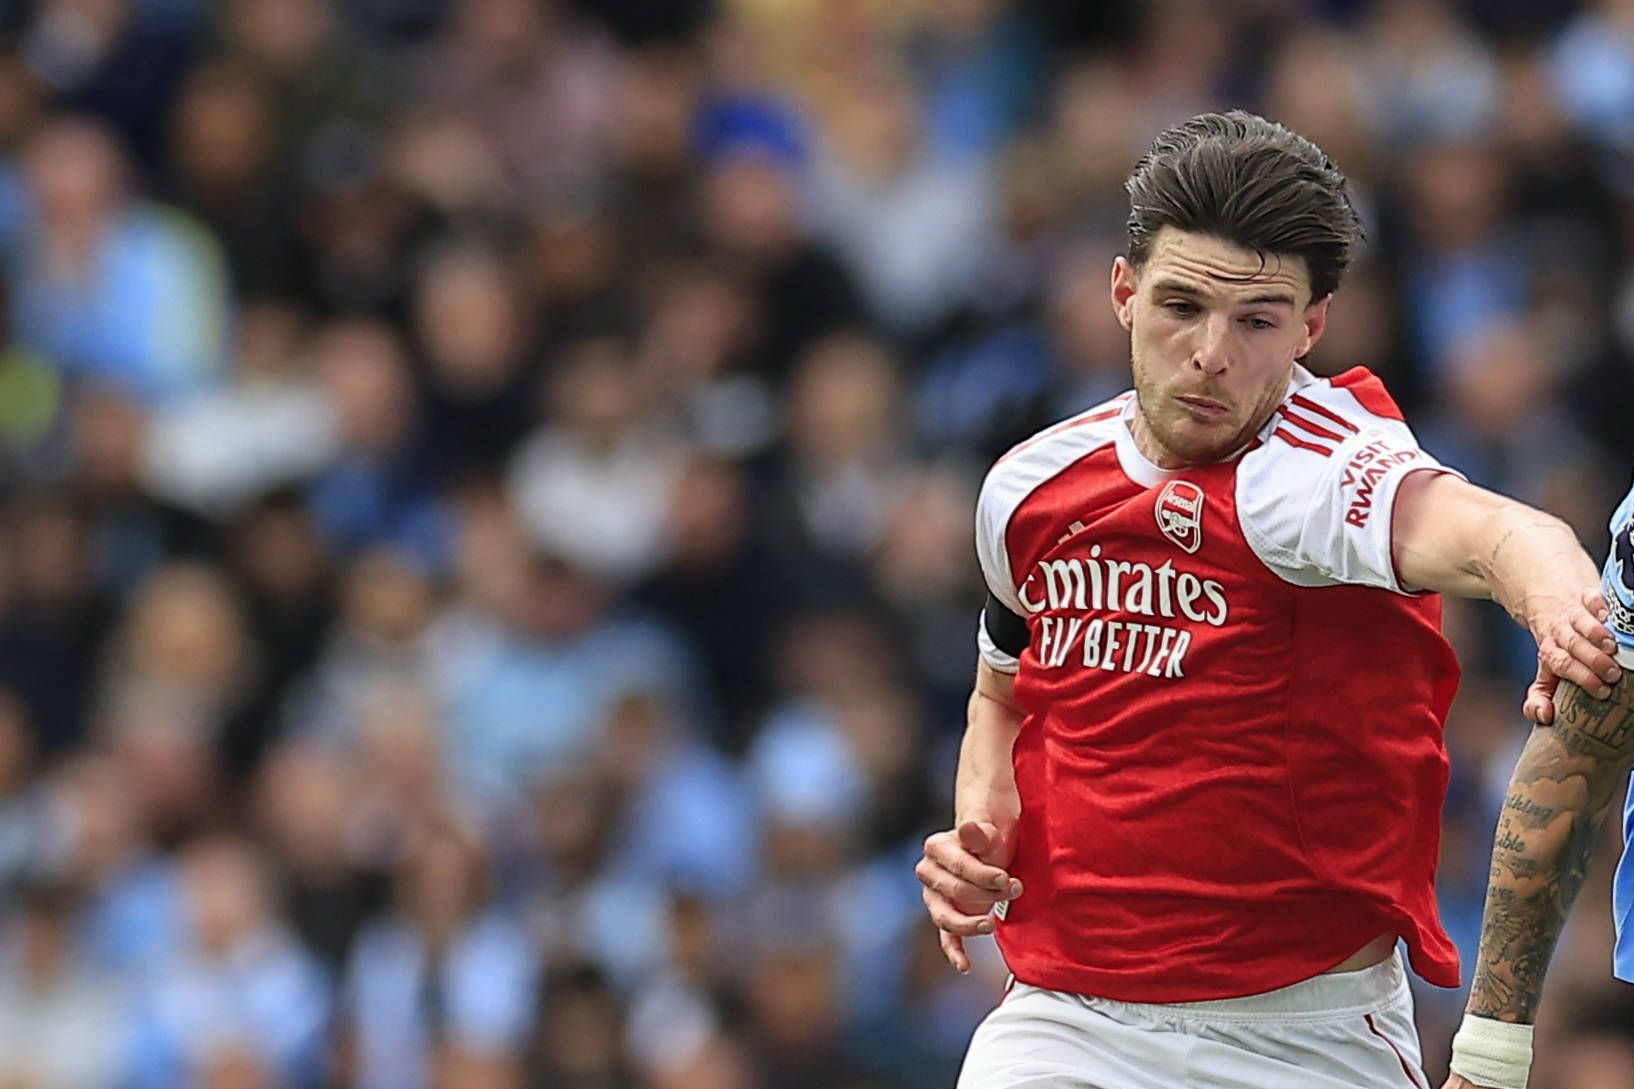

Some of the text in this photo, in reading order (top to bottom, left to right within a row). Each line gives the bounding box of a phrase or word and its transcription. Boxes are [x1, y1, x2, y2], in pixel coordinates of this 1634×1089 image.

[1340, 441, 1390, 488] VISIT
[1345, 449, 1421, 529] RWAND
[1018, 544, 1228, 626] Emirates
[1083, 619, 1190, 678] BETTER
